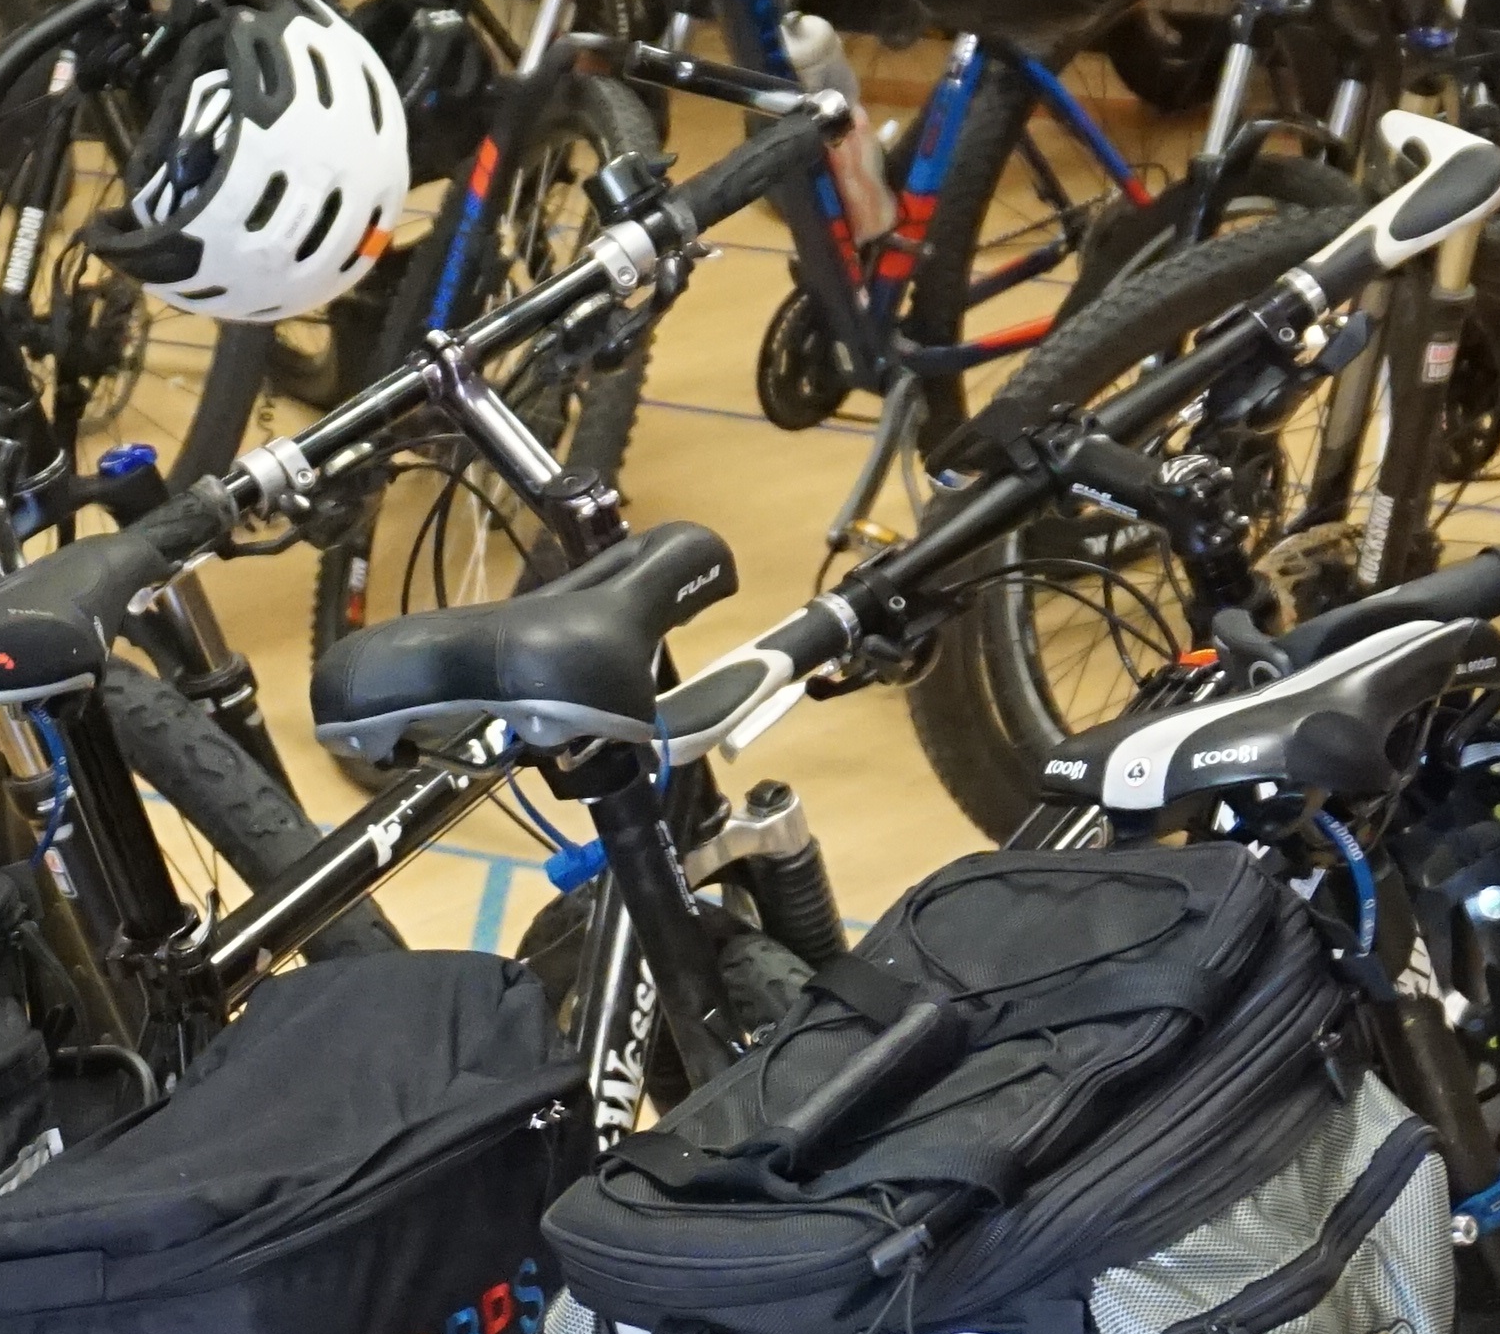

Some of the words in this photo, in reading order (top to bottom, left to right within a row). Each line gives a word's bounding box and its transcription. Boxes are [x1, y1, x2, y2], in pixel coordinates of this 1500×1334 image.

[676, 563, 721, 605] FUJI
[1043, 758, 1089, 781] KOOBI
[1192, 744, 1259, 771] KOOBI
